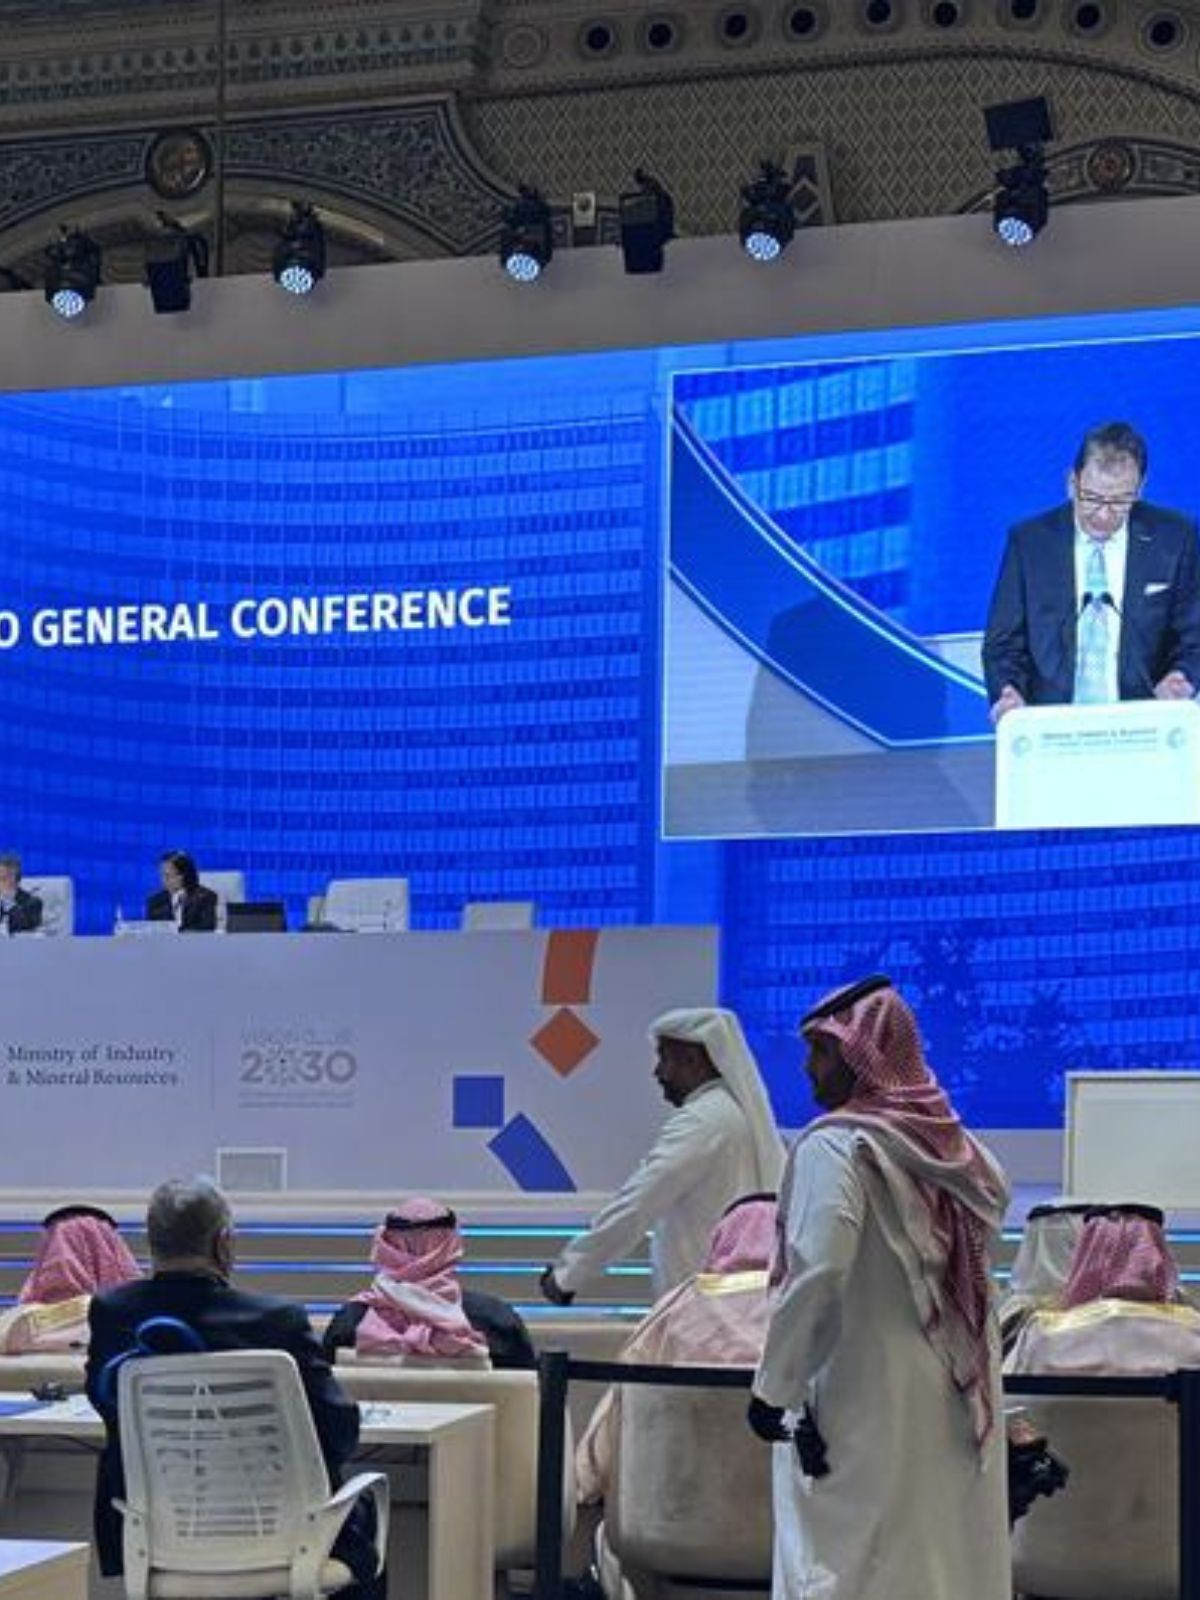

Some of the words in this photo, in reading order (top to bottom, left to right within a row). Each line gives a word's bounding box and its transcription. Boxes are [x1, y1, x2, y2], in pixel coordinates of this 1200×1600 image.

[32, 602, 219, 647] GENERAL
[231, 586, 511, 638] CONFERENCE
[7, 1045, 73, 1064] Ministry
[80, 1044, 99, 1061] of
[105, 1045, 175, 1064] Industry
[26, 1068, 90, 1085] Mineral
[93, 1069, 178, 1086] Resources
